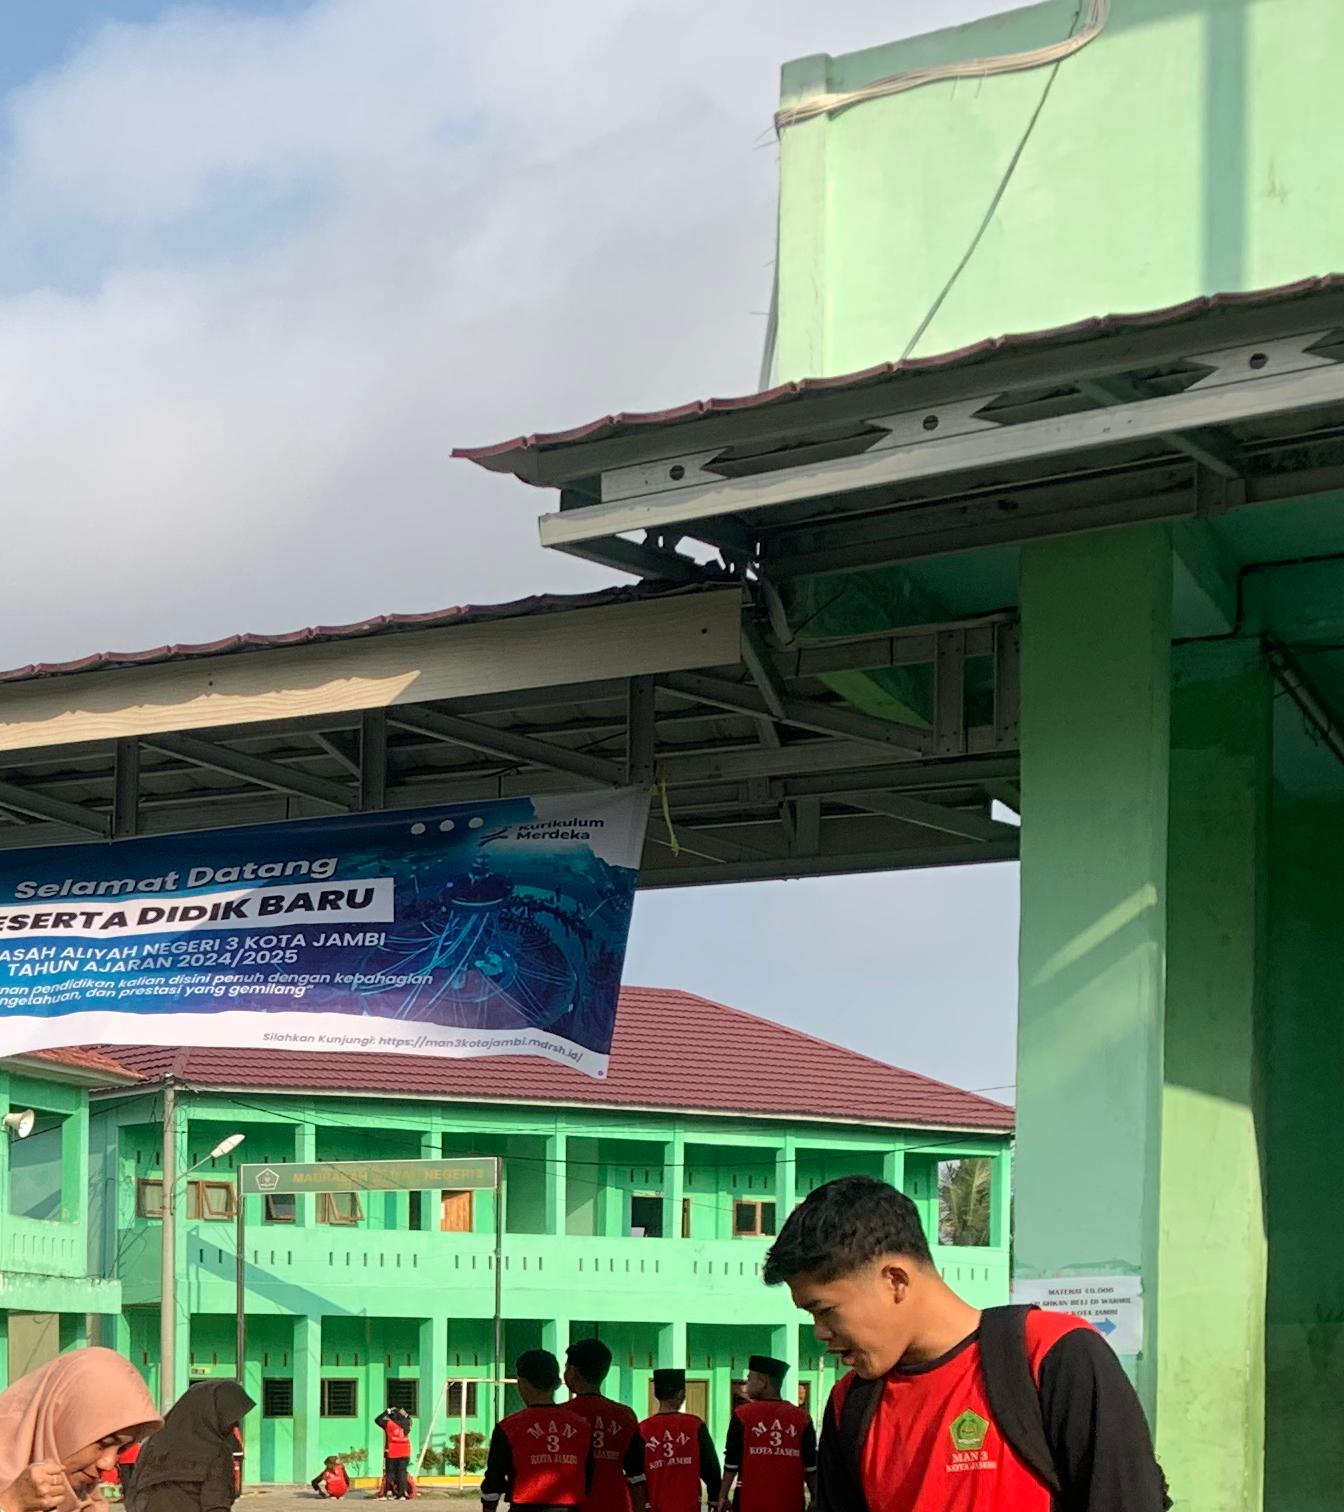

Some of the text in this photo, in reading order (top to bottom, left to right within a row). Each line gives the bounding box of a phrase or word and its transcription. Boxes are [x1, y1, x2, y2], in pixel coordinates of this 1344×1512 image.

[516, 829, 591, 841] Merdeka
[14, 856, 339, 899] Selamat Datang
[136, 898, 253, 926] DIDIK
[257, 887, 376, 918] BARU
[59, 944, 137, 961] ALIYAH
[138, 938, 220, 956] NEGERI
[224, 937, 239, 950] 3
[244, 934, 308, 950] KOTA
[312, 931, 387, 947] JAMBI
[7, 949, 298, 977] TAHUN AJARAN 2024/2025
[30, 977, 115, 997] pendidikan
[118, 974, 168, 989] kalian
[168, 972, 212, 986] disini
[212, 972, 265, 988] penuh
[267, 971, 331, 989] dengan
[85, 988, 117, 999] dan
[118, 983, 183, 999] prestasi
[183, 984, 225, 997] yang
[262, 1032, 315, 1044] Silahkan
[526, 1419, 578, 1440] MAN
[751, 1418, 799, 1438] MAN
[546, 1434, 560, 1453] 3
[592, 1430, 605, 1448] 3
[645, 1429, 691, 1453] MAN
[768, 1430, 783, 1447] 3
[663, 1441, 675, 1458] 3
[748, 1446, 773, 1456] KOTA
[952, 1451, 989, 1463] MAN 3
[530, 1454, 553, 1465] KOTA
[945, 1461, 997, 1473] KOTA JAMBI
